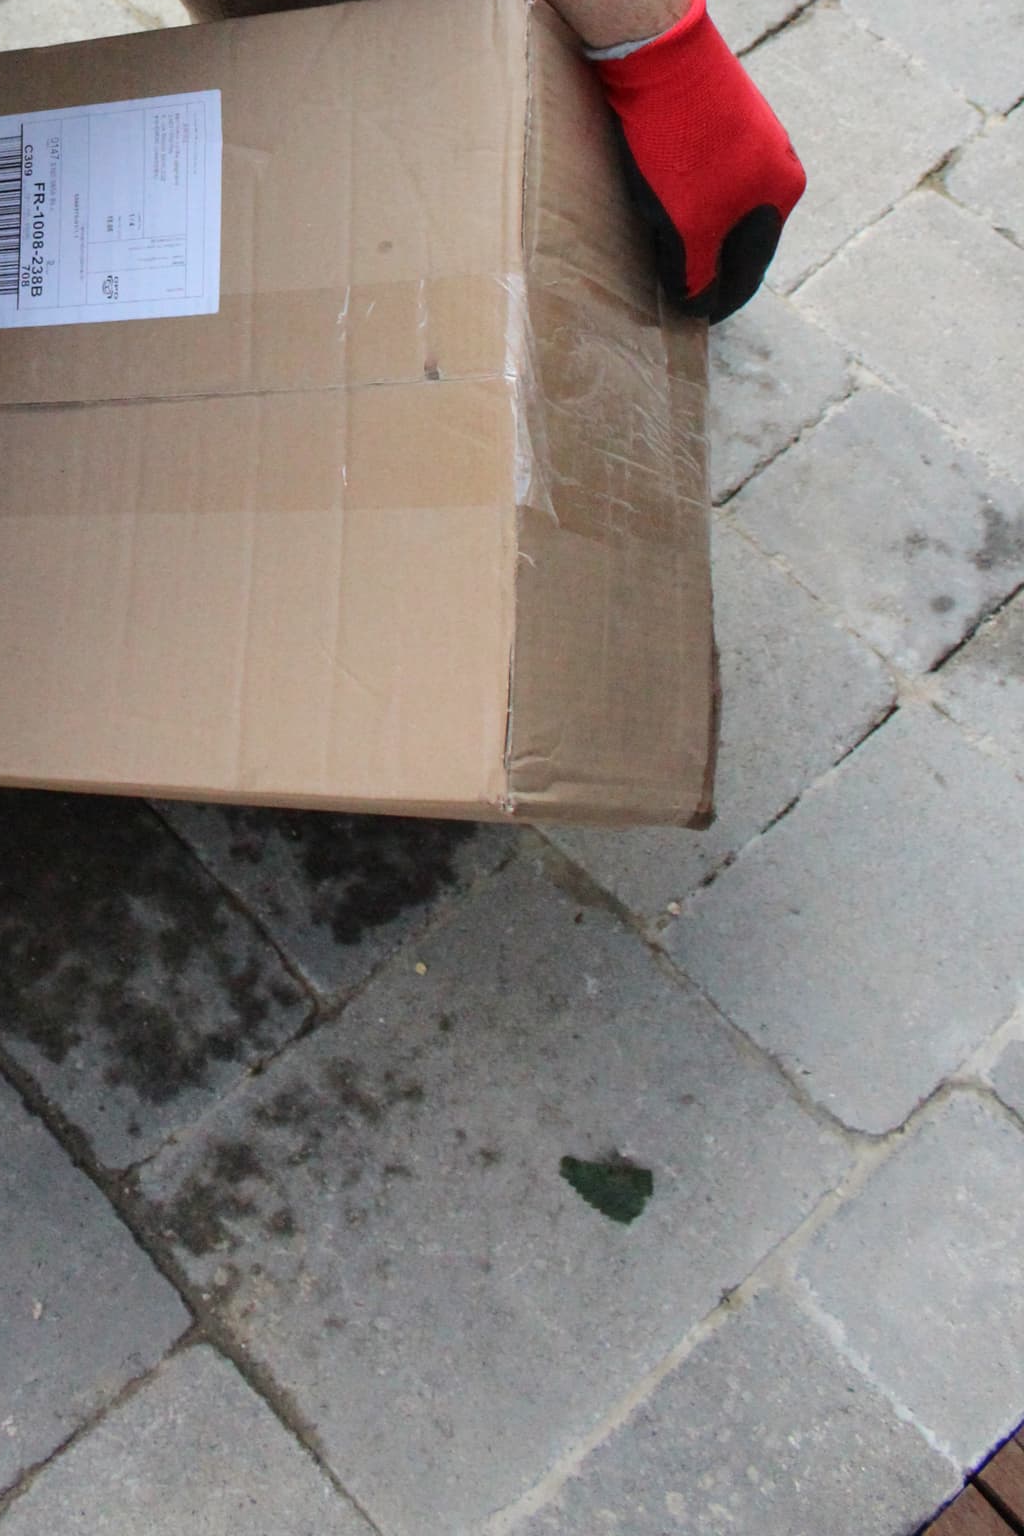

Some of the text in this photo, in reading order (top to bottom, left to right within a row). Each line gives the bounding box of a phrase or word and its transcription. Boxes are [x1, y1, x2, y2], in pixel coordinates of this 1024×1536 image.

[23, 144, 34, 177] C309
[31, 182, 46, 298] FR-1008-238B
[21, 265, 31, 288] 708
